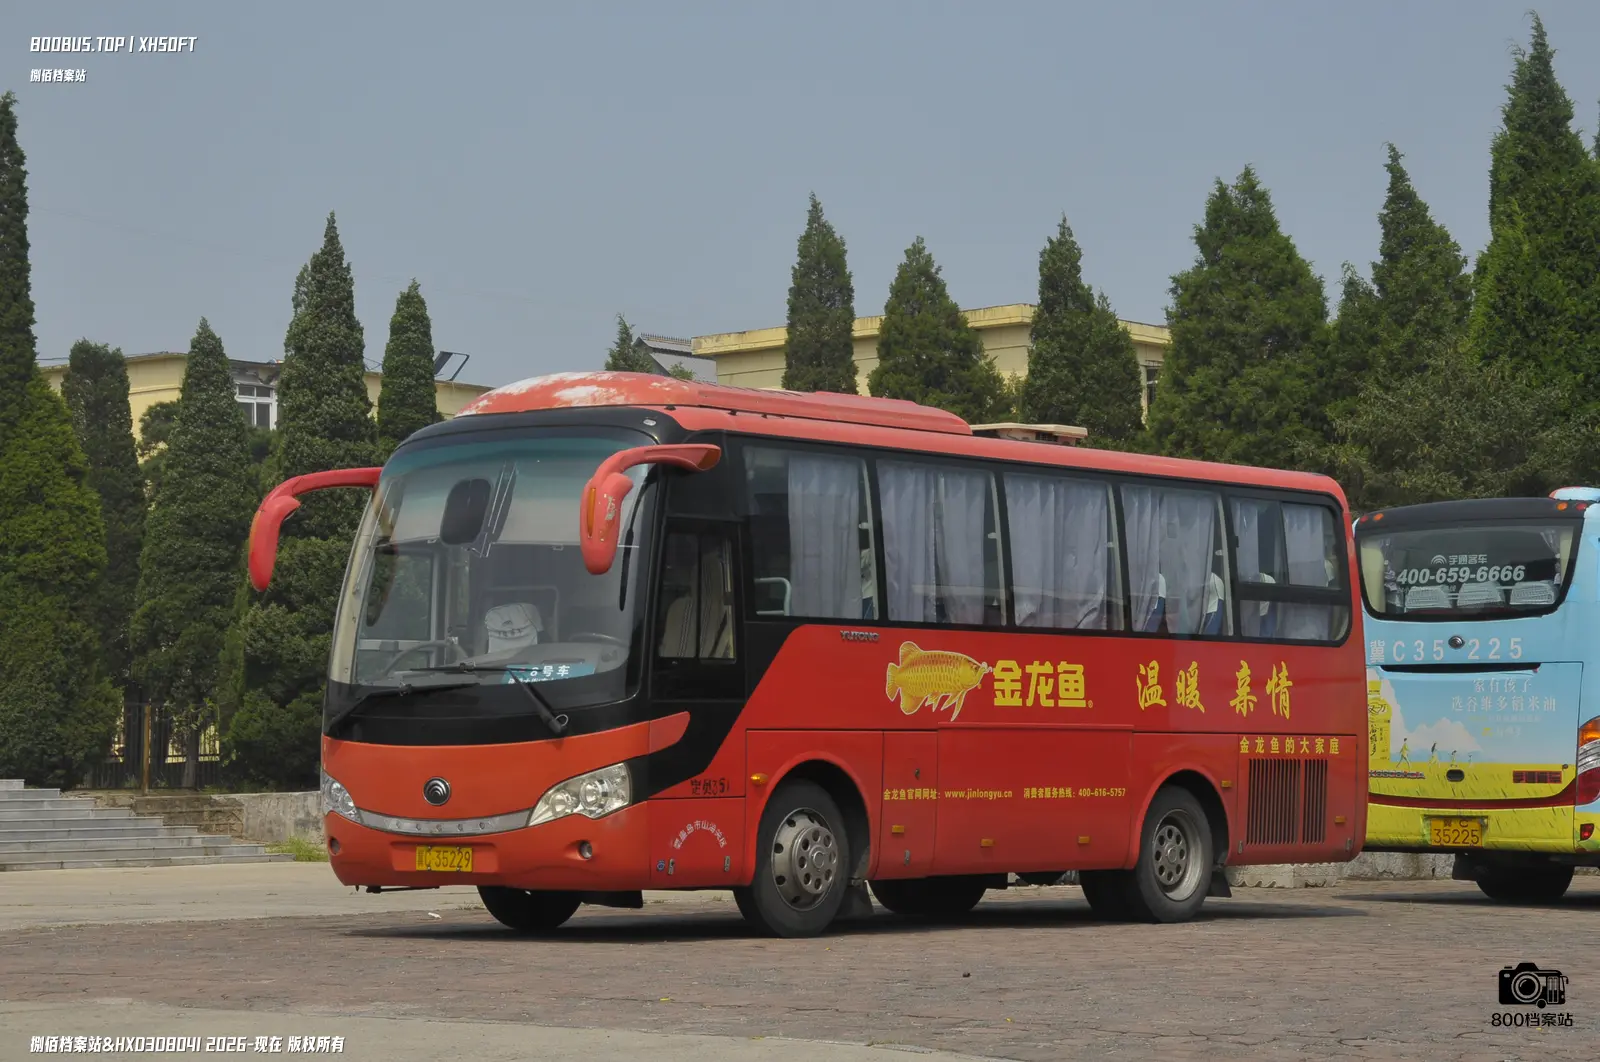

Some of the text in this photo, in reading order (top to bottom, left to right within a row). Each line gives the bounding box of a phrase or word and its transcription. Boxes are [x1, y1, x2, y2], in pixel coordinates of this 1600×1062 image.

[1448, 554, 1488, 565] 宇通客车
[1397, 565, 1526, 585] 400-659-6666
[993, 660, 1087, 708] 金龙鱼
[1239, 736, 1340, 755] 金龙鱼的大家庭
[1079, 788, 1126, 797] 400-616-5757
[1433, 828, 1480, 845] 35225
